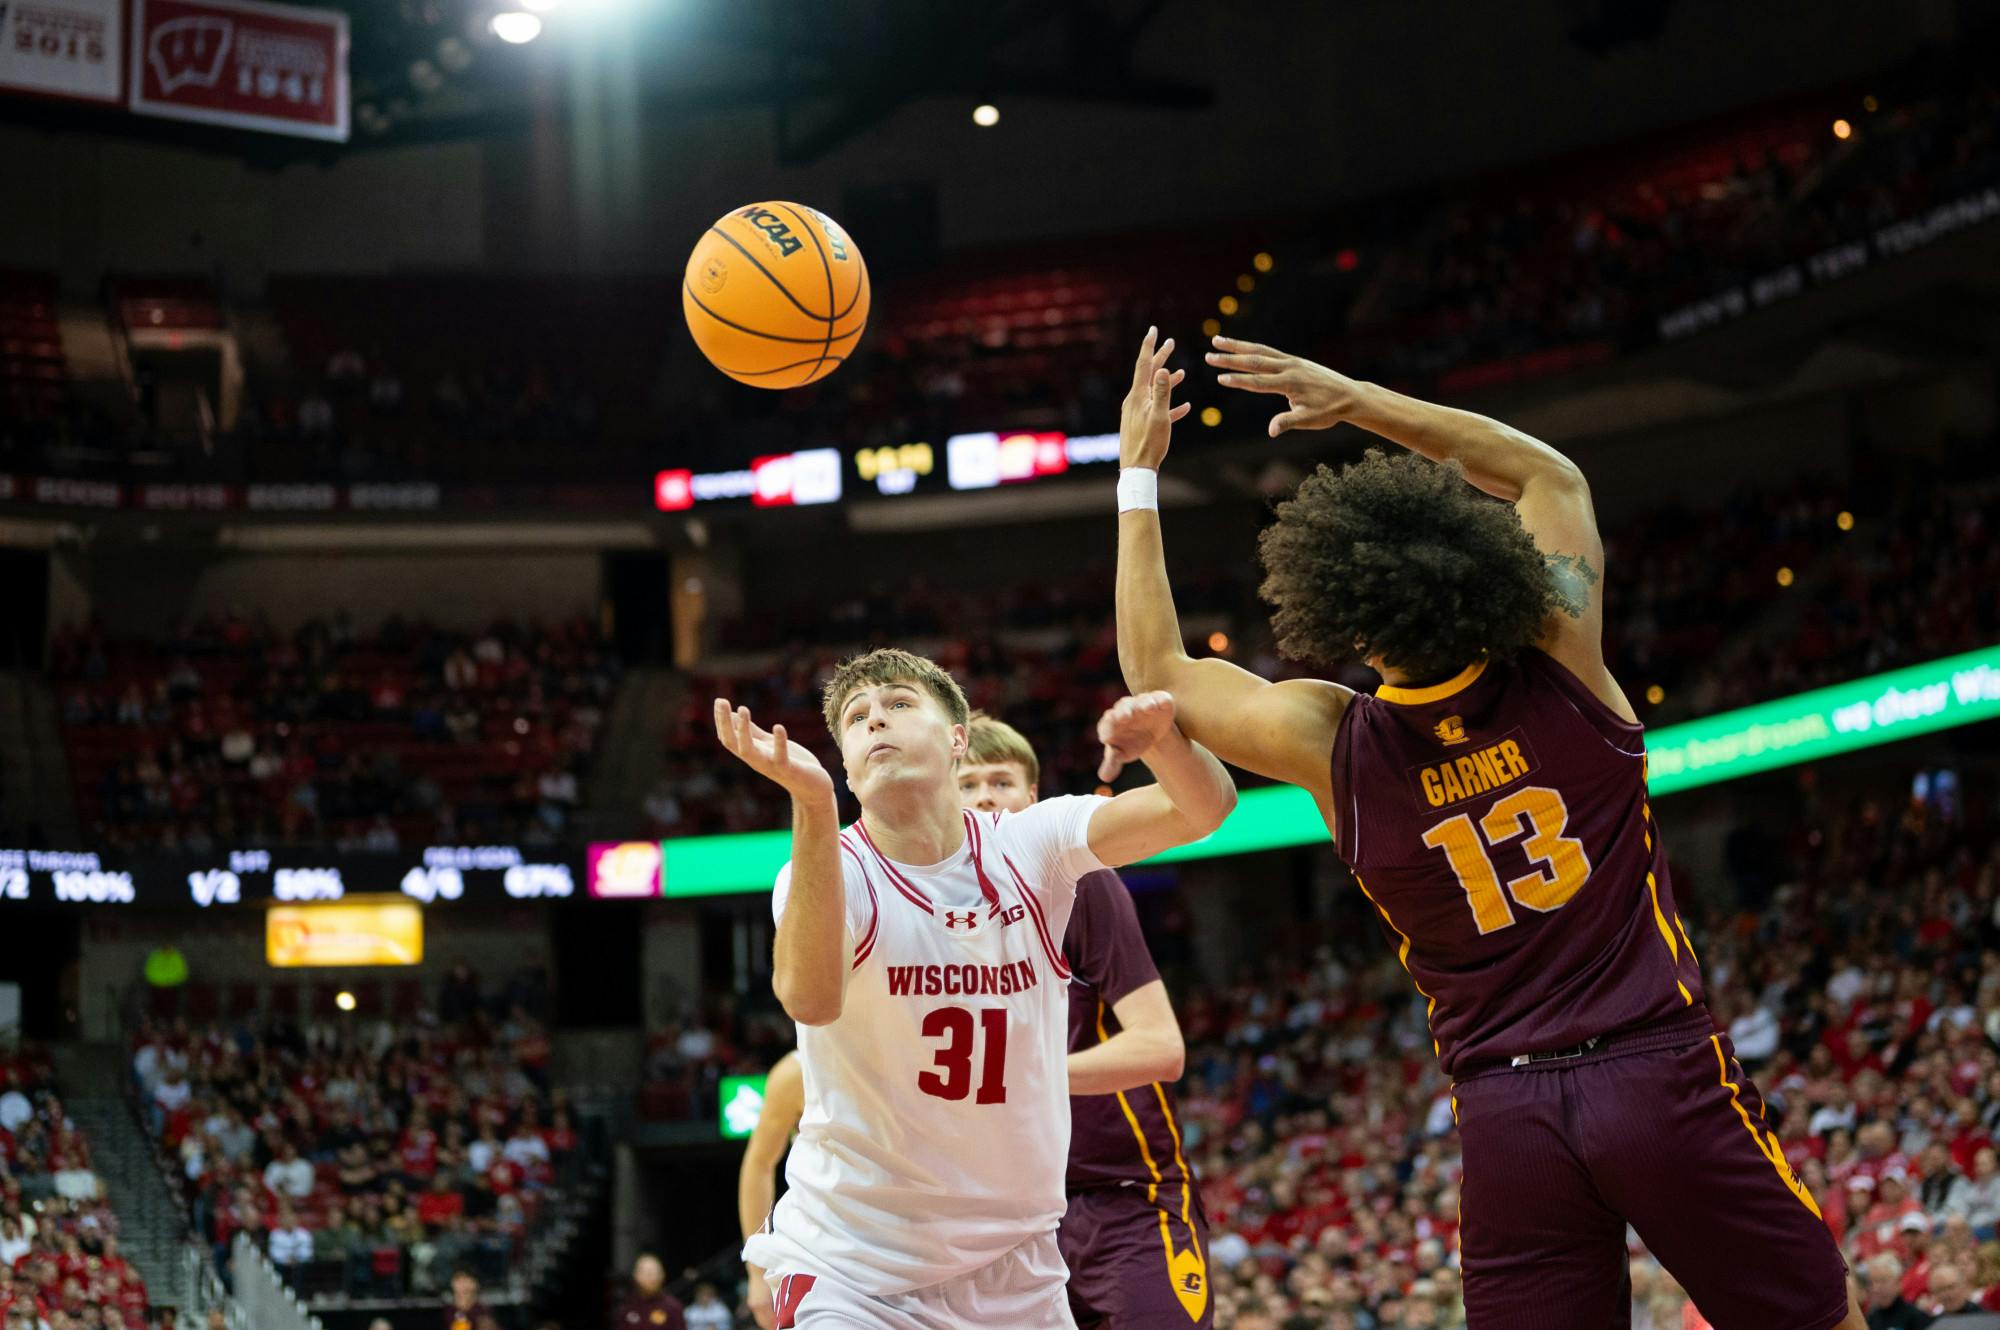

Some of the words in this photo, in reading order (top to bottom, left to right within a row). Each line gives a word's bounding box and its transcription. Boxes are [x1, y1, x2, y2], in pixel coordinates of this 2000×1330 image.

[740, 206, 803, 257] NCAA
[1420, 739, 1529, 807] GARNER
[0, 867, 29, 899] /2
[1421, 786, 1592, 935] 13
[52, 870, 136, 903] 100%
[887, 957, 1038, 996] WISCONSIN
[918, 1006, 1007, 1105] 31
